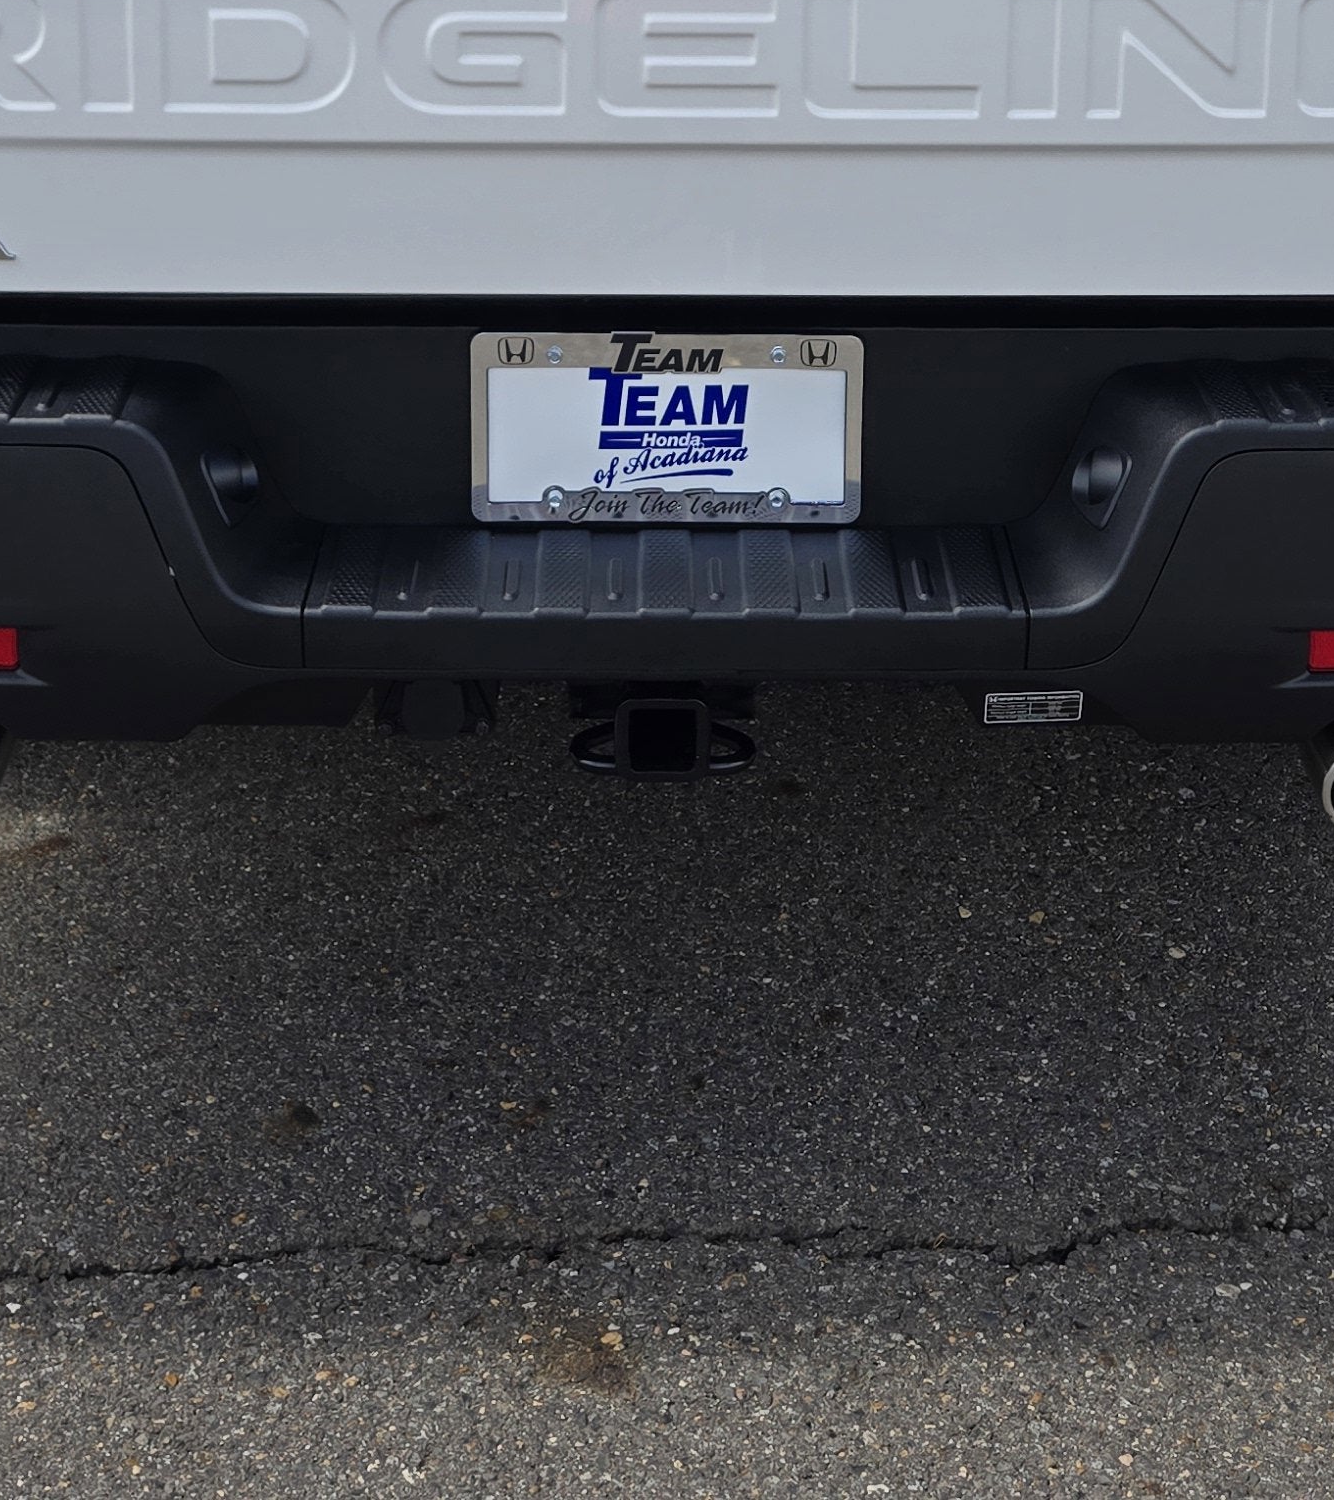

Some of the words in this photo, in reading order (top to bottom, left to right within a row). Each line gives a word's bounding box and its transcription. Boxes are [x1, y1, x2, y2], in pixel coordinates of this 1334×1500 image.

[641, 432, 702, 448] Honda
[593, 457, 620, 489] of
[623, 444, 749, 475] Acadiana
[568, 490, 631, 522] Join
[635, 491, 681, 515] The
[685, 491, 765, 515] Team!
